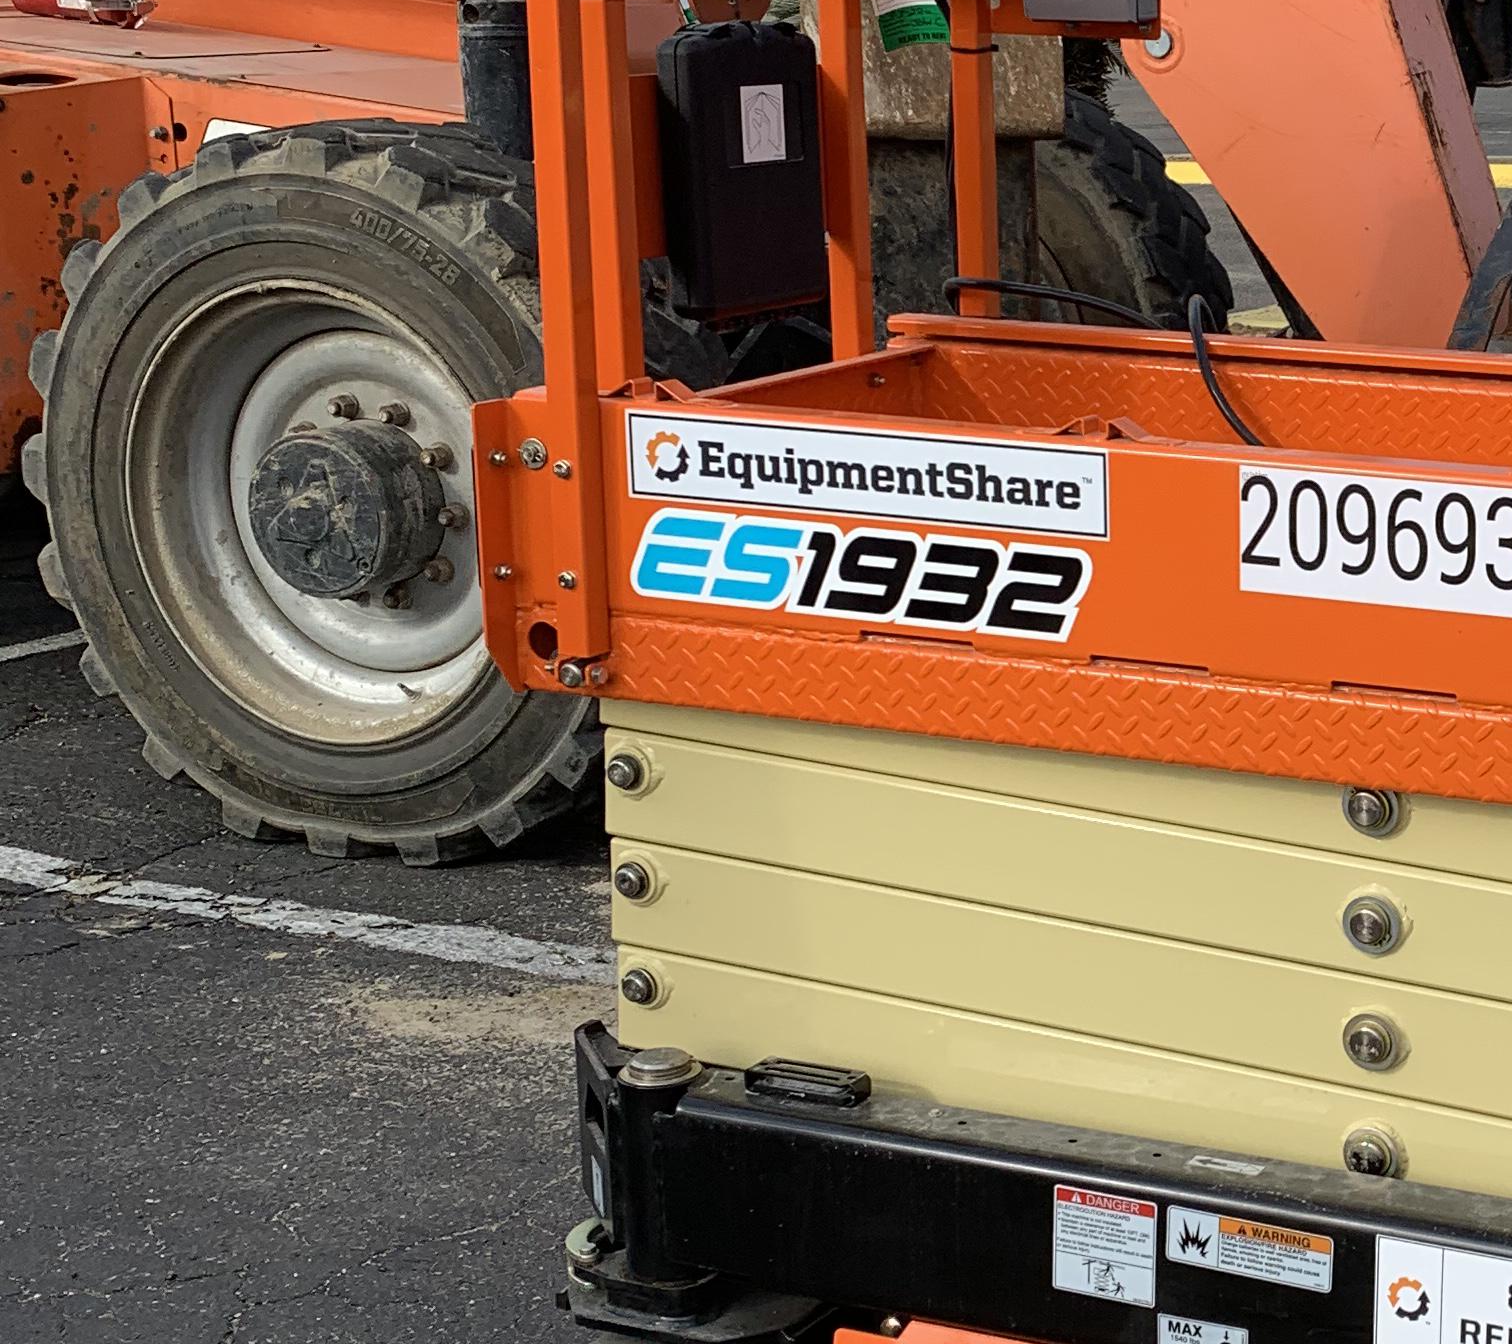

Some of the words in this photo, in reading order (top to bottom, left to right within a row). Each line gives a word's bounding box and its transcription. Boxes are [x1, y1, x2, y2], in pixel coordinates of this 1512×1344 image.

[697, 439, 1082, 511] EquipmentShare
[636, 515, 1085, 635] ES1932
[1086, 1195, 1140, 1214] DANGER
[1251, 1226, 1311, 1248] WARNING
[1168, 1320, 1202, 1338] MAX
[1171, 1334, 1188, 1344] 1540
